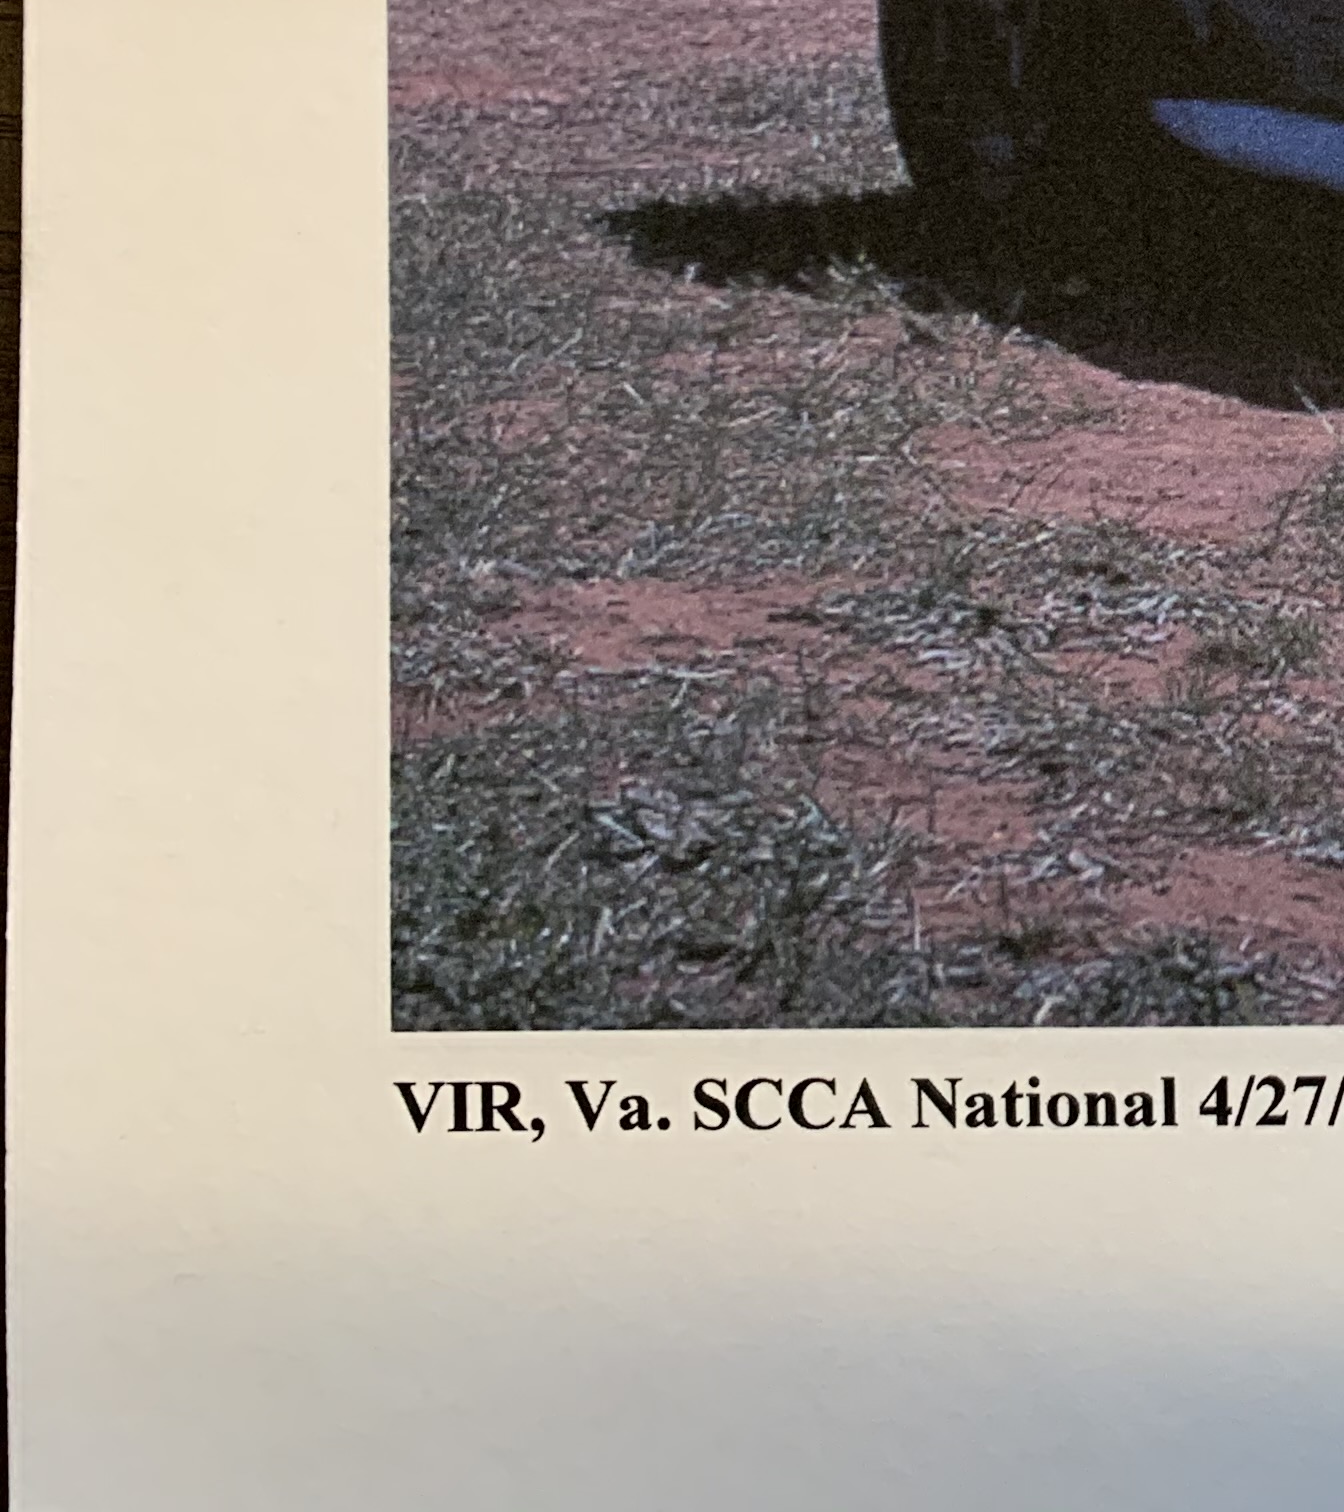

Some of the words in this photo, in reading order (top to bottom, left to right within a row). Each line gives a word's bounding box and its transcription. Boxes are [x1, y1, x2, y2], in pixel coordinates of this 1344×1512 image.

[392, 1080, 546, 1144] VIR,
[563, 1079, 672, 1133] Va.
[692, 1076, 893, 1132] SCCA
[909, 1075, 1179, 1130] National
